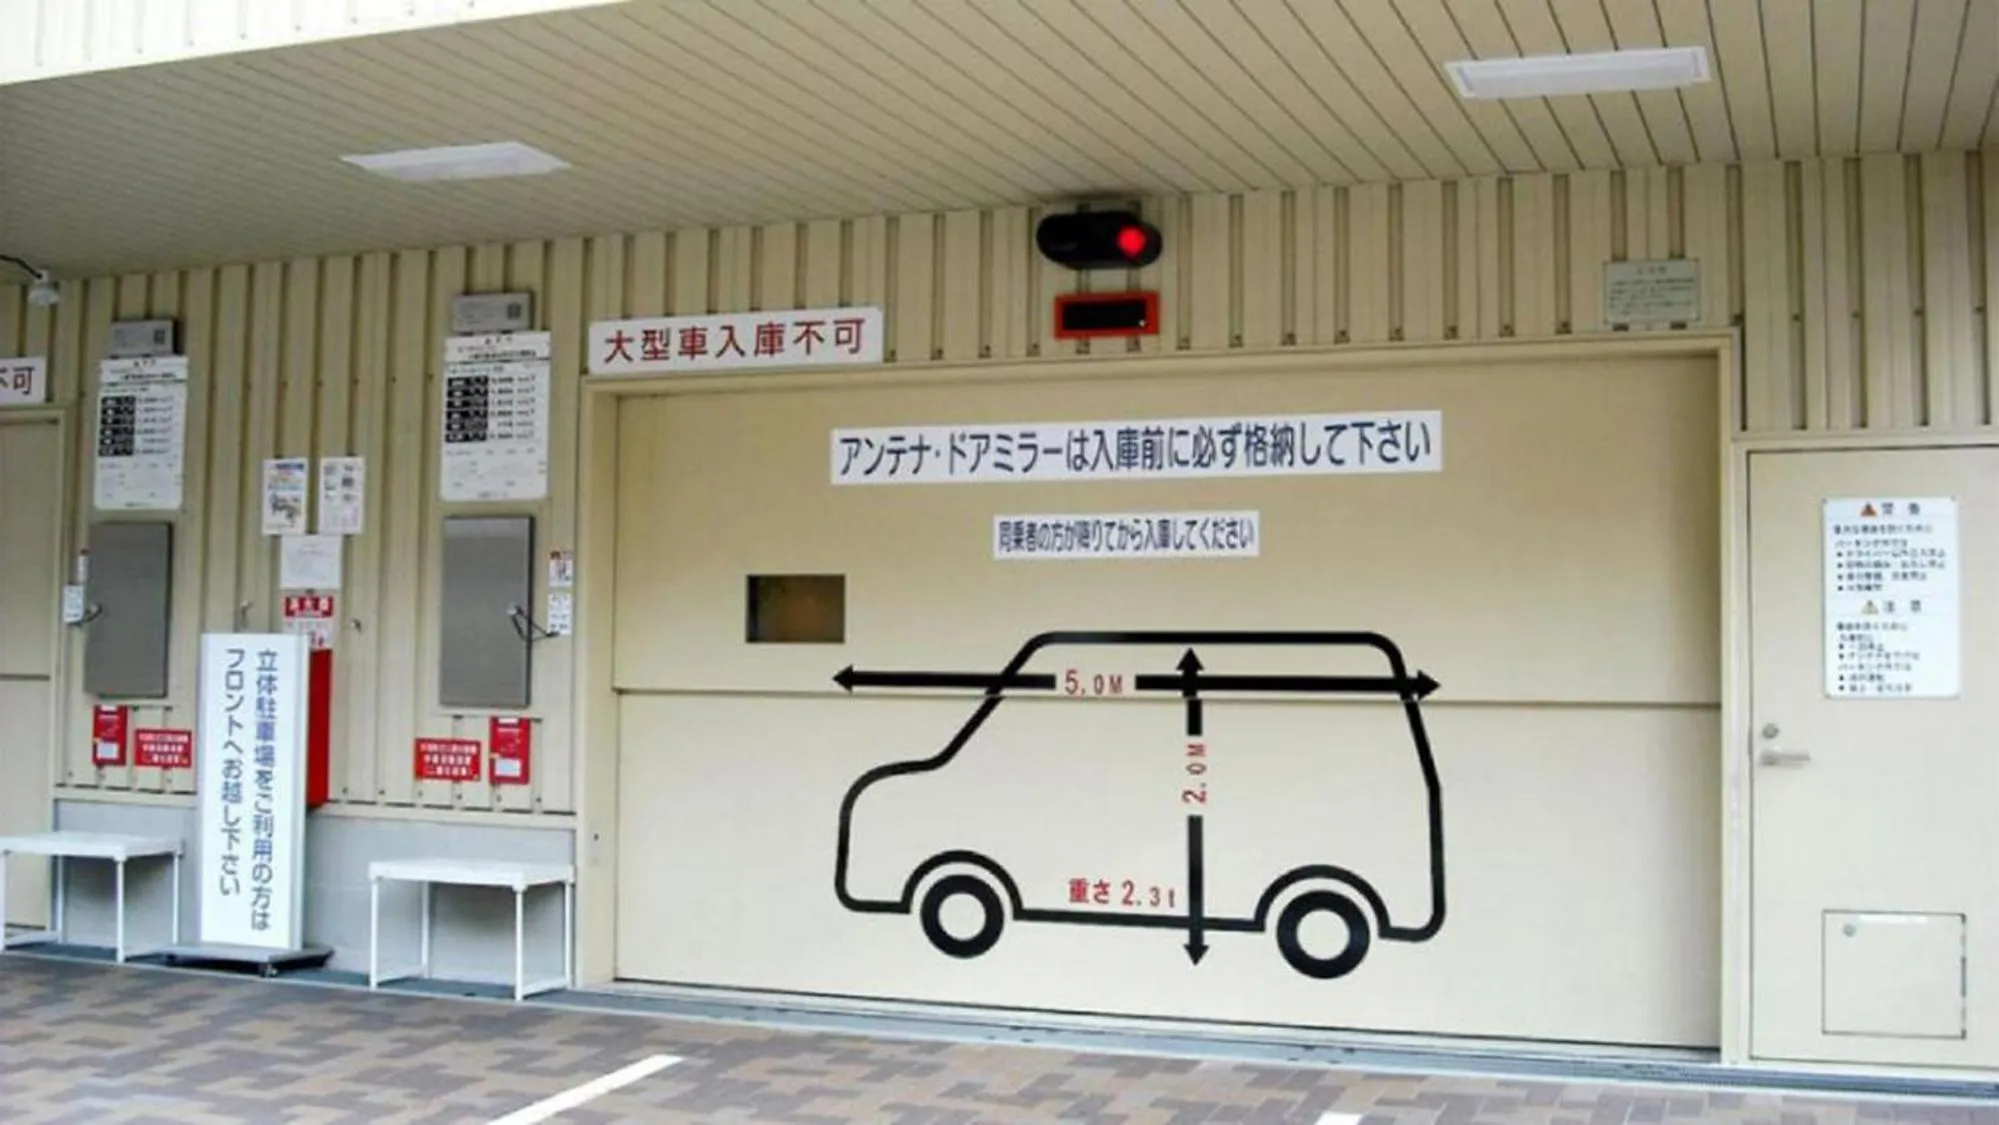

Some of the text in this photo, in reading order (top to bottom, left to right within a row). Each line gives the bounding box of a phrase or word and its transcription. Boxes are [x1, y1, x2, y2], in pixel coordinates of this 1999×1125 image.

[604, 317, 865, 364] 大型車入庫不可
